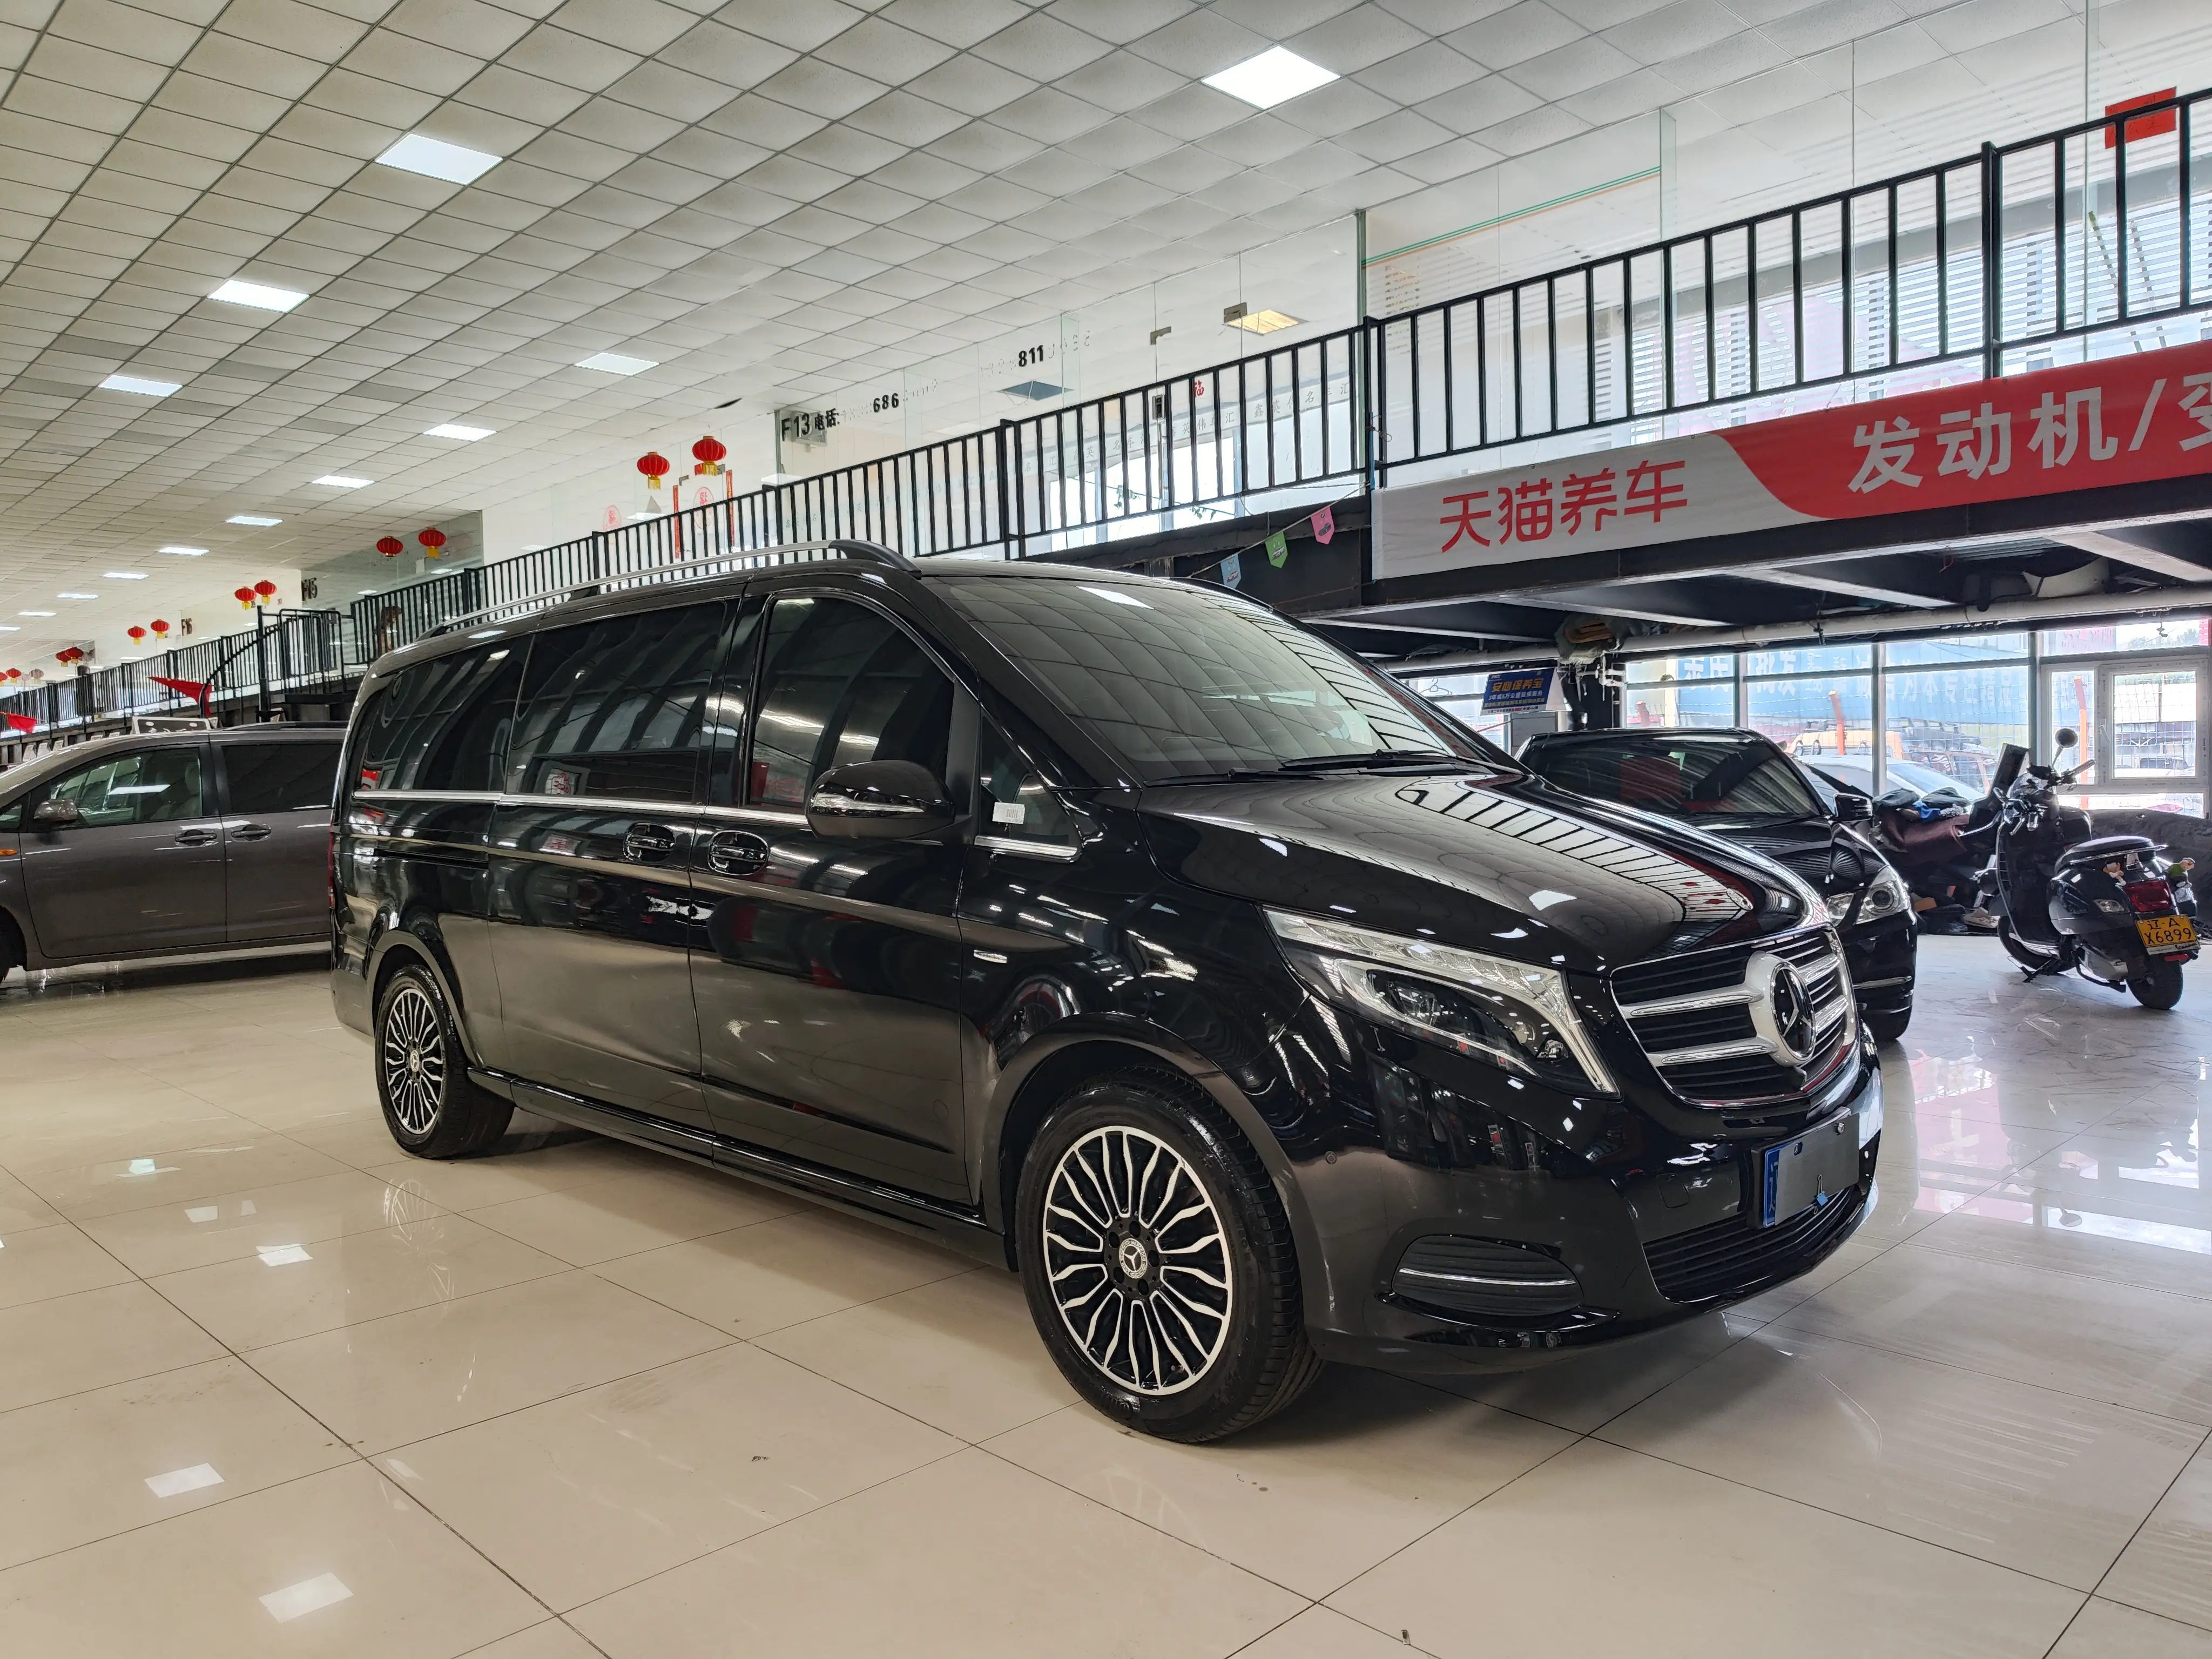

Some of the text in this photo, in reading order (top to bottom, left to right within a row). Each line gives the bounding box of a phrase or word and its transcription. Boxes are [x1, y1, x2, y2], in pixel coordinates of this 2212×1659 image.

[1440, 460, 1688, 553] 天猫养车
[2144, 928, 2191, 945] X6899
